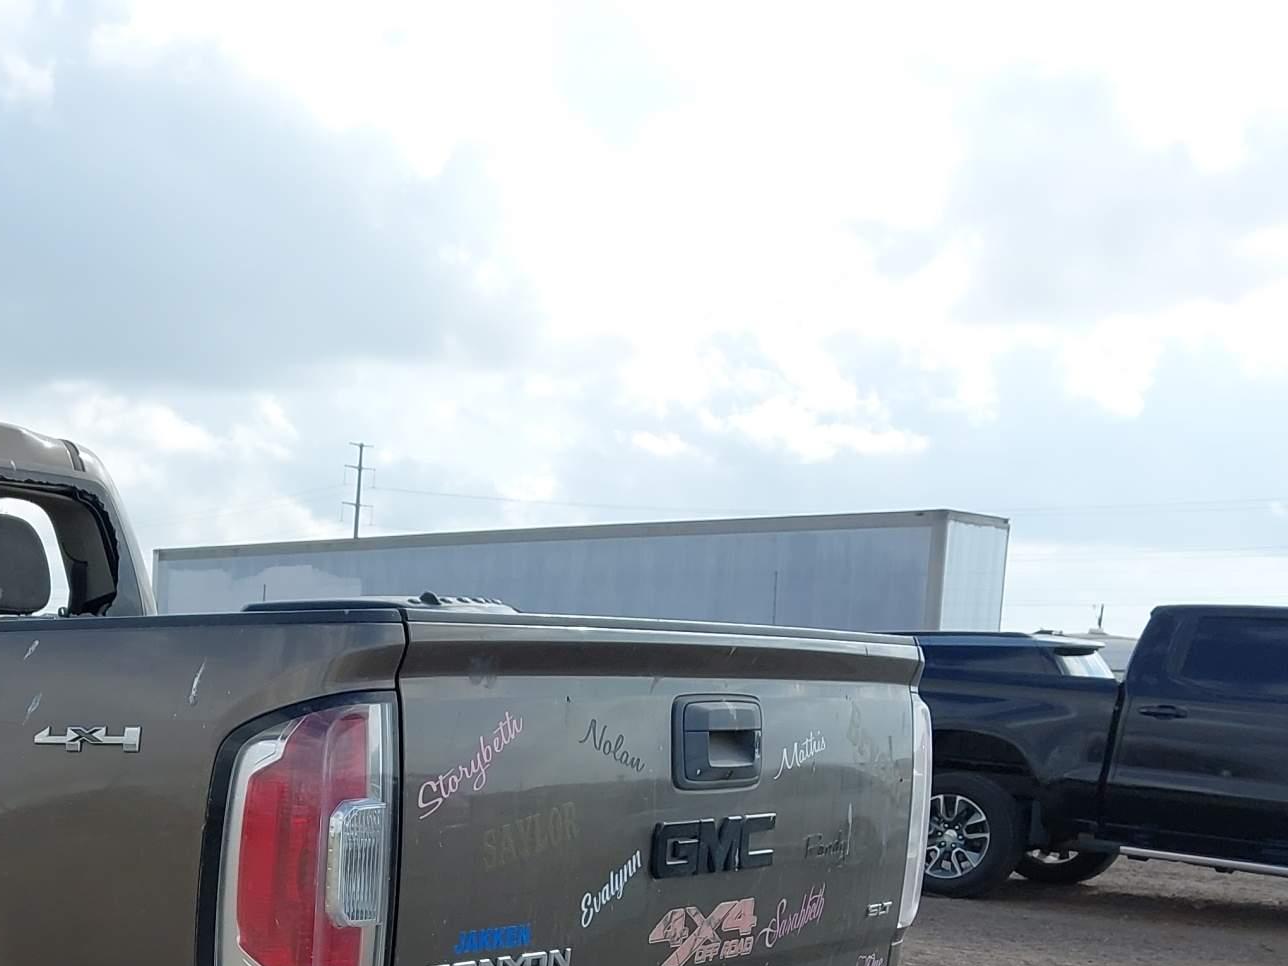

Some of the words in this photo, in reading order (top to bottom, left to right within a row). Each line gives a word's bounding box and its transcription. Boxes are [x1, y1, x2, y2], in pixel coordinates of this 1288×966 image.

[417, 711, 523, 820] Storybeth
[579, 719, 645, 773] Nolan
[773, 730, 826, 780] Mathis
[650, 812, 777, 879] GMC
[580, 849, 642, 928] Evalynn
[866, 901, 893, 917] SLT
[694, 942, 721, 965] OFF
[719, 935, 754, 959] ROAD
